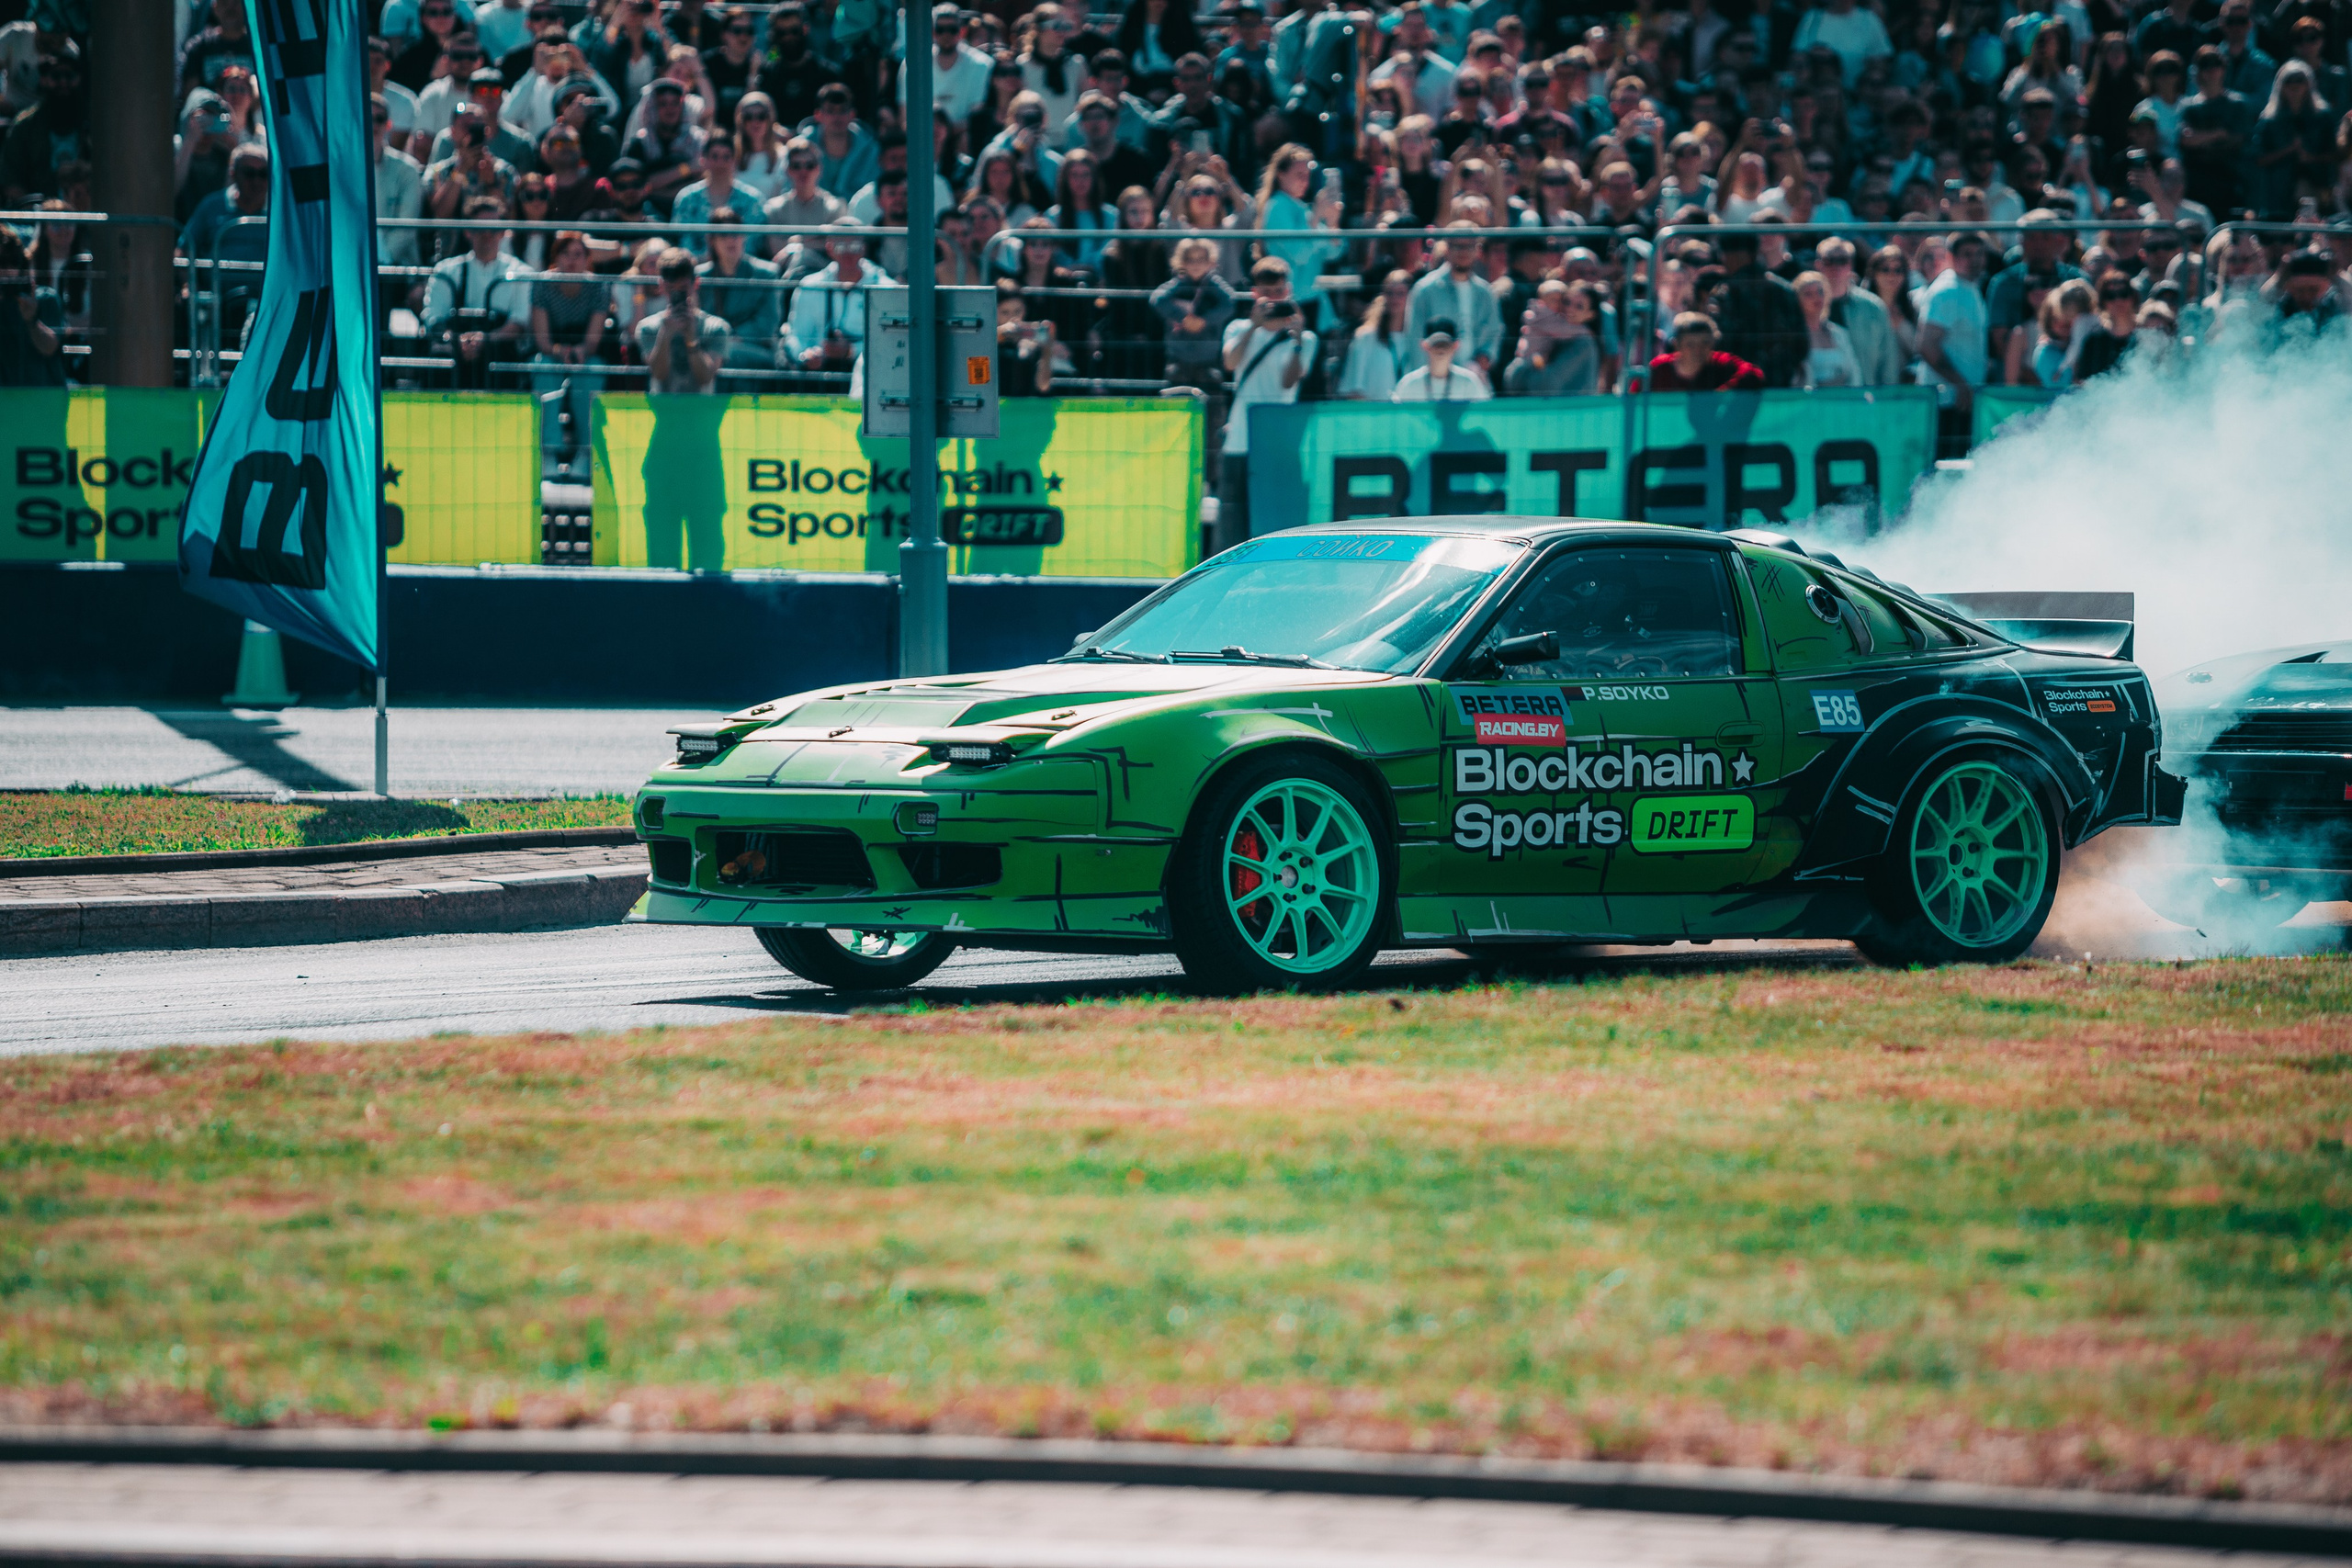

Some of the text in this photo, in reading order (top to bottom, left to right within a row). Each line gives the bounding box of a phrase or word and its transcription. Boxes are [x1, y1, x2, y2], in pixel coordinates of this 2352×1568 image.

[957, 512, 1052, 540] DRIFT
[1582, 685, 1670, 701] P.SOYKO
[2043, 689, 2105, 700] Blockchain
[1812, 695, 1861, 726] E85
[2048, 701, 2088, 714] Sports
[1479, 721, 1560, 738] RACING.BY
[1455, 743, 1723, 792] Blockchain
[1453, 801, 1739, 857] Sports DRIFT
